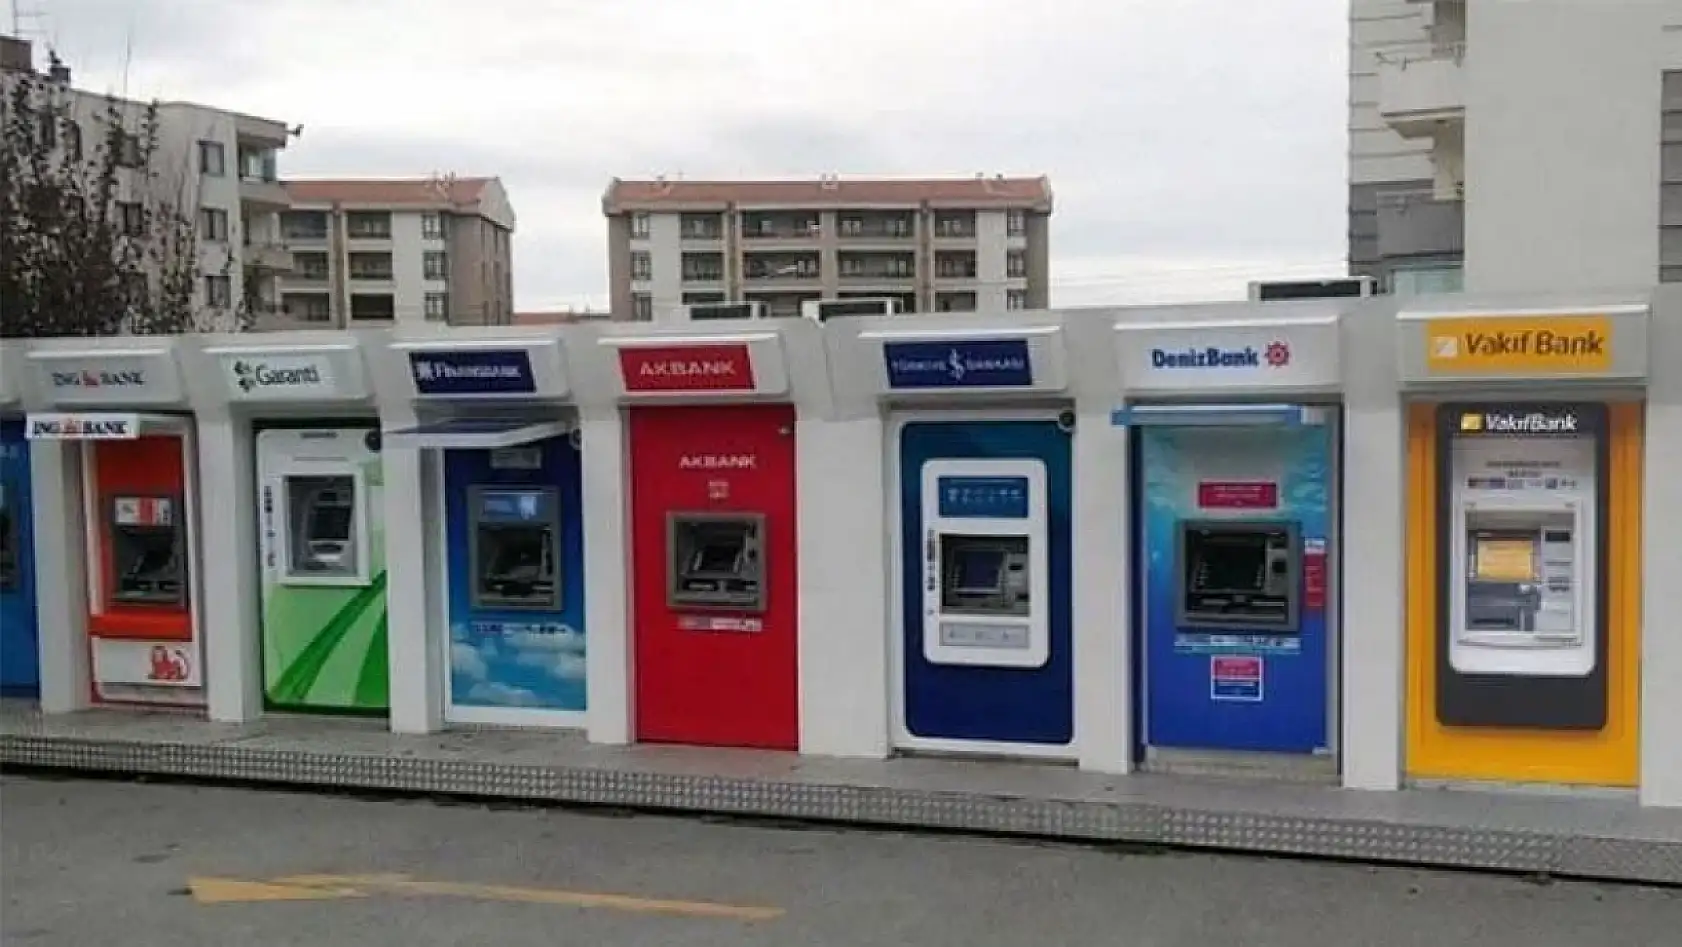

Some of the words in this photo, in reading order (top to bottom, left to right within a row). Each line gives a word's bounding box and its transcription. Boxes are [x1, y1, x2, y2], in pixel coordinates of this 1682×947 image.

[1536, 330, 1605, 355] Bank
[1152, 346, 1259, 367] DenizBank
[256, 364, 320, 386] Garanti
[640, 360, 736, 376] AKBANK
[51, 371, 80, 386] ING
[99, 369, 145, 386] BANK
[33, 420, 62, 435] ING
[82, 420, 128, 435] BANK
[679, 454, 757, 469] AKBANK
